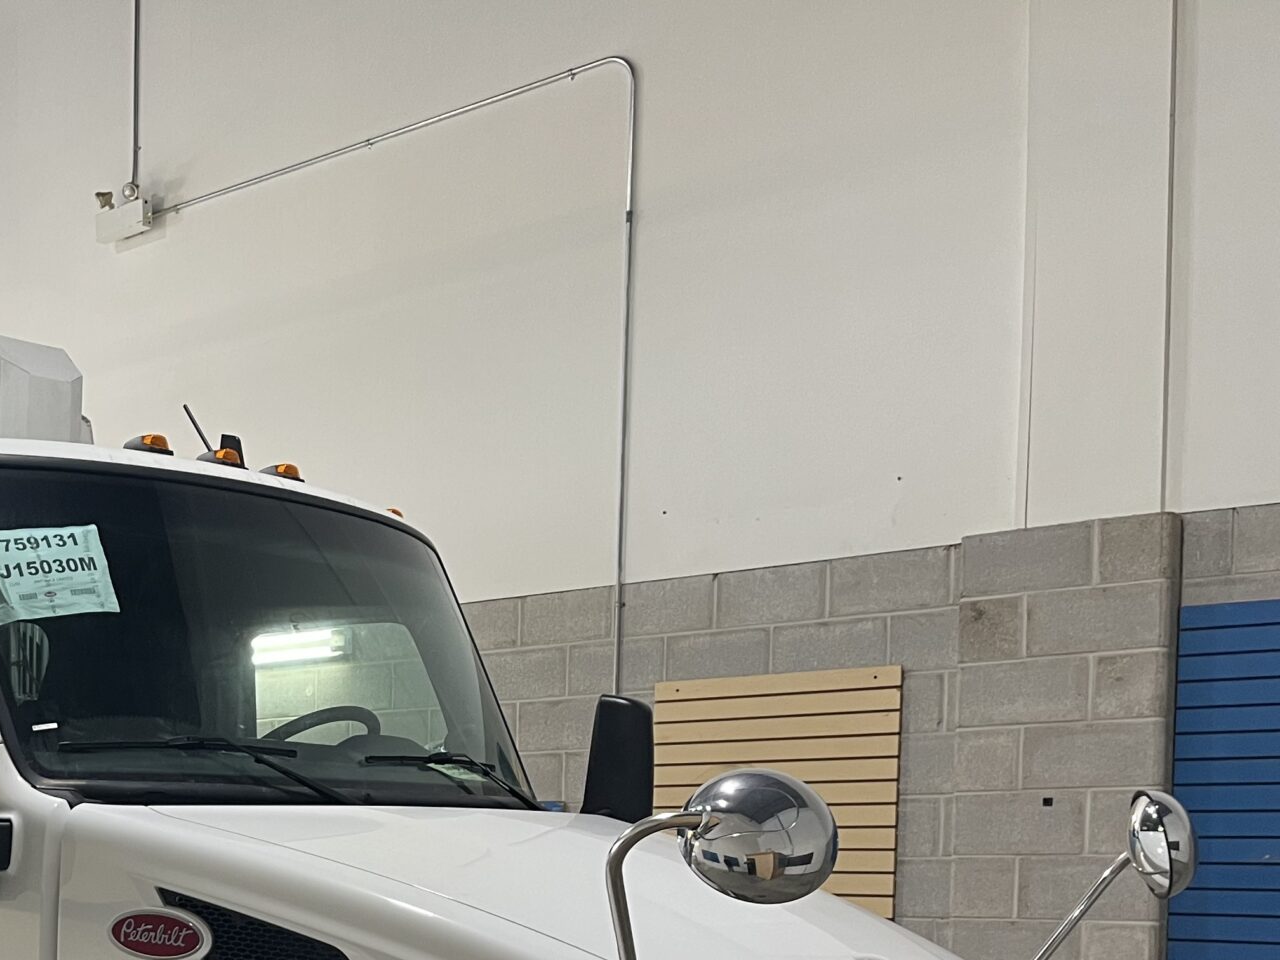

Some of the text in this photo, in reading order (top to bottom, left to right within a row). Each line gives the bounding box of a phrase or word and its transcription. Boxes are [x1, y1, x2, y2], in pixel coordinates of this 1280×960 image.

[0, 533, 79, 552] 759131
[0, 556, 98, 579] J15030M
[120, 918, 194, 947] Peterbilt
